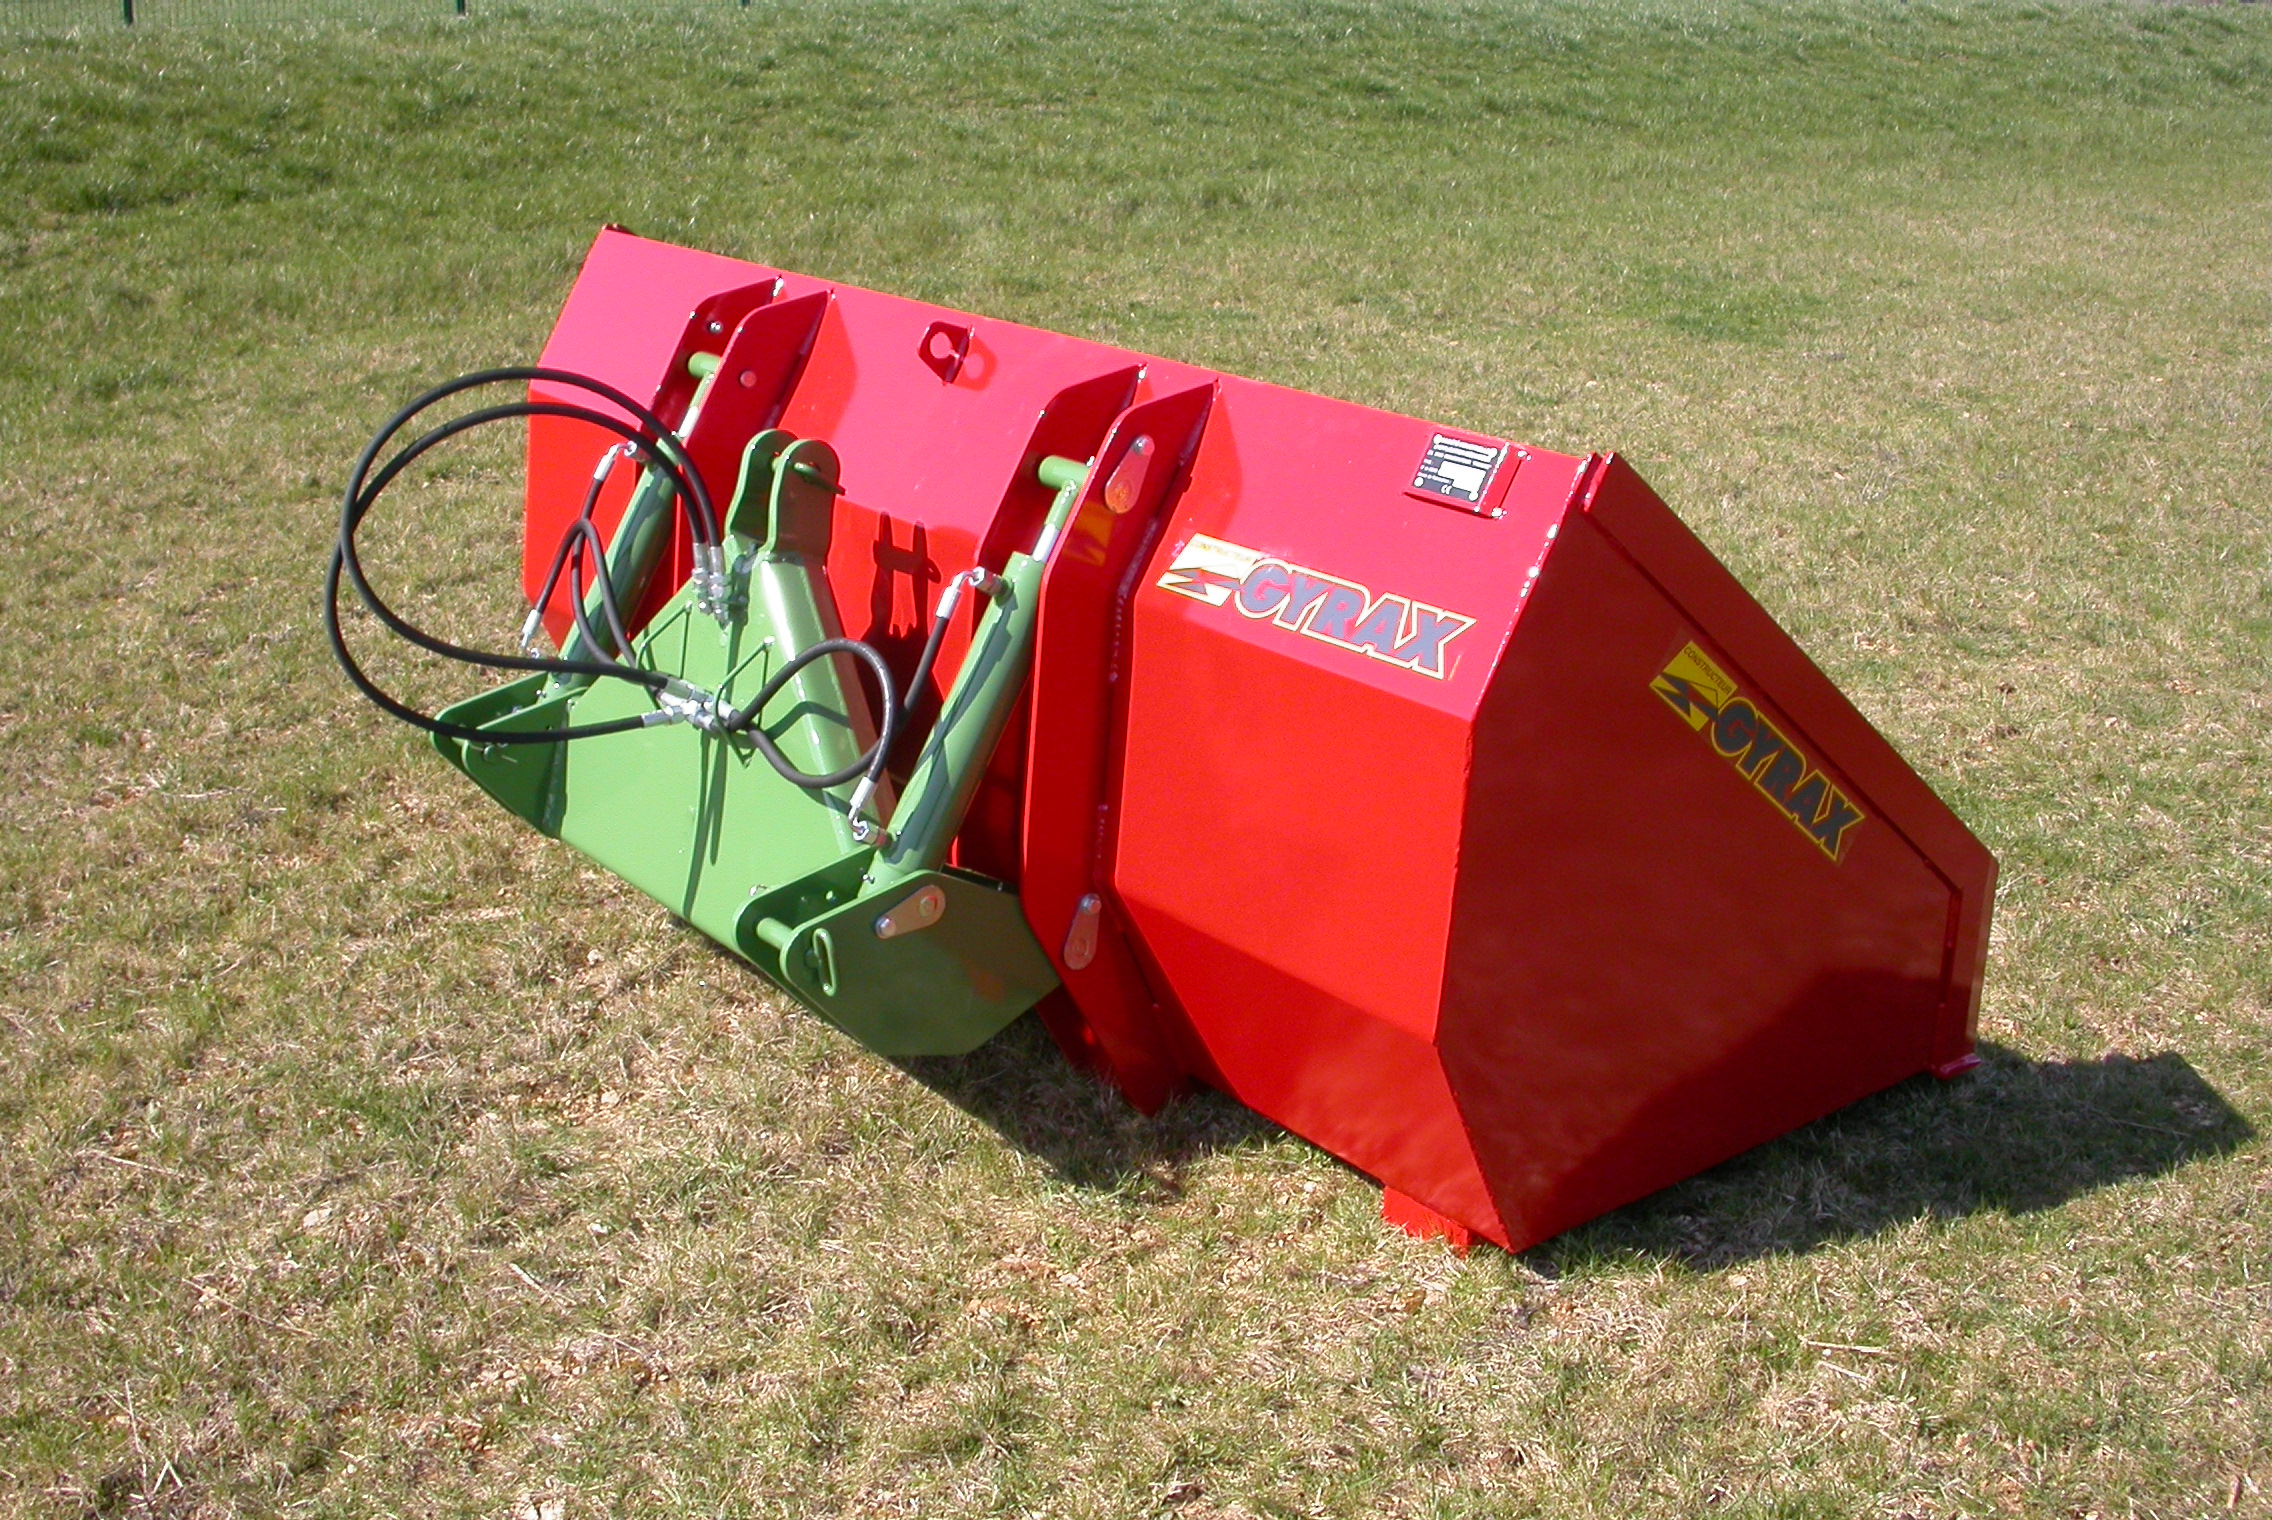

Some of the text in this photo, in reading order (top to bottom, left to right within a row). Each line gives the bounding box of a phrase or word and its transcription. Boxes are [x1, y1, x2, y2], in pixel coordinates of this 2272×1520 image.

[1238, 561, 1466, 673] GYRAX
[1683, 646, 1733, 695] CONSTRUCTEUR
[1713, 701, 1862, 858] GYRAX
